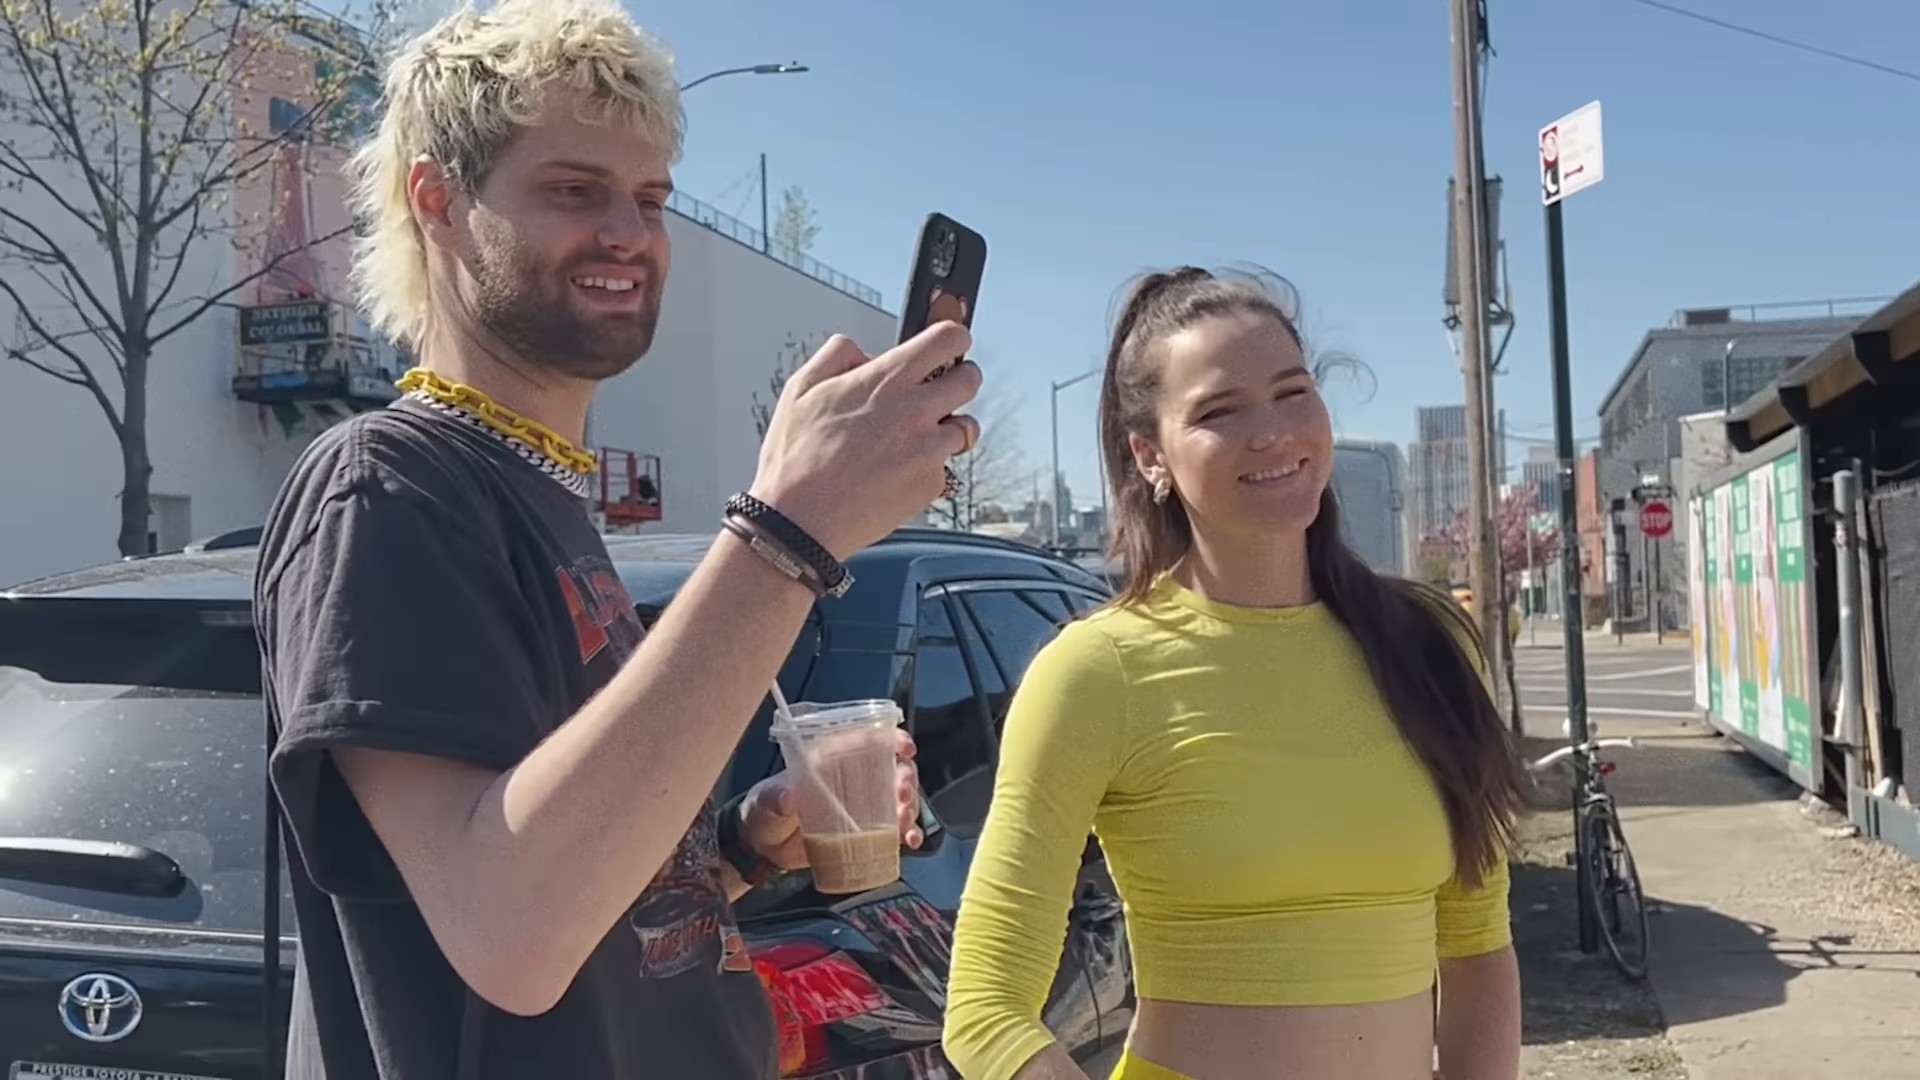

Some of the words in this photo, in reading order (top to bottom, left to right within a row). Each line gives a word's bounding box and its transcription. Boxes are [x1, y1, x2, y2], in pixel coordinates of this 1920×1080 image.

[1641, 512, 1671, 528] STOP
[32, 1063, 87, 1077] PRESTIGE
[93, 1067, 141, 1080] TOYOTA
